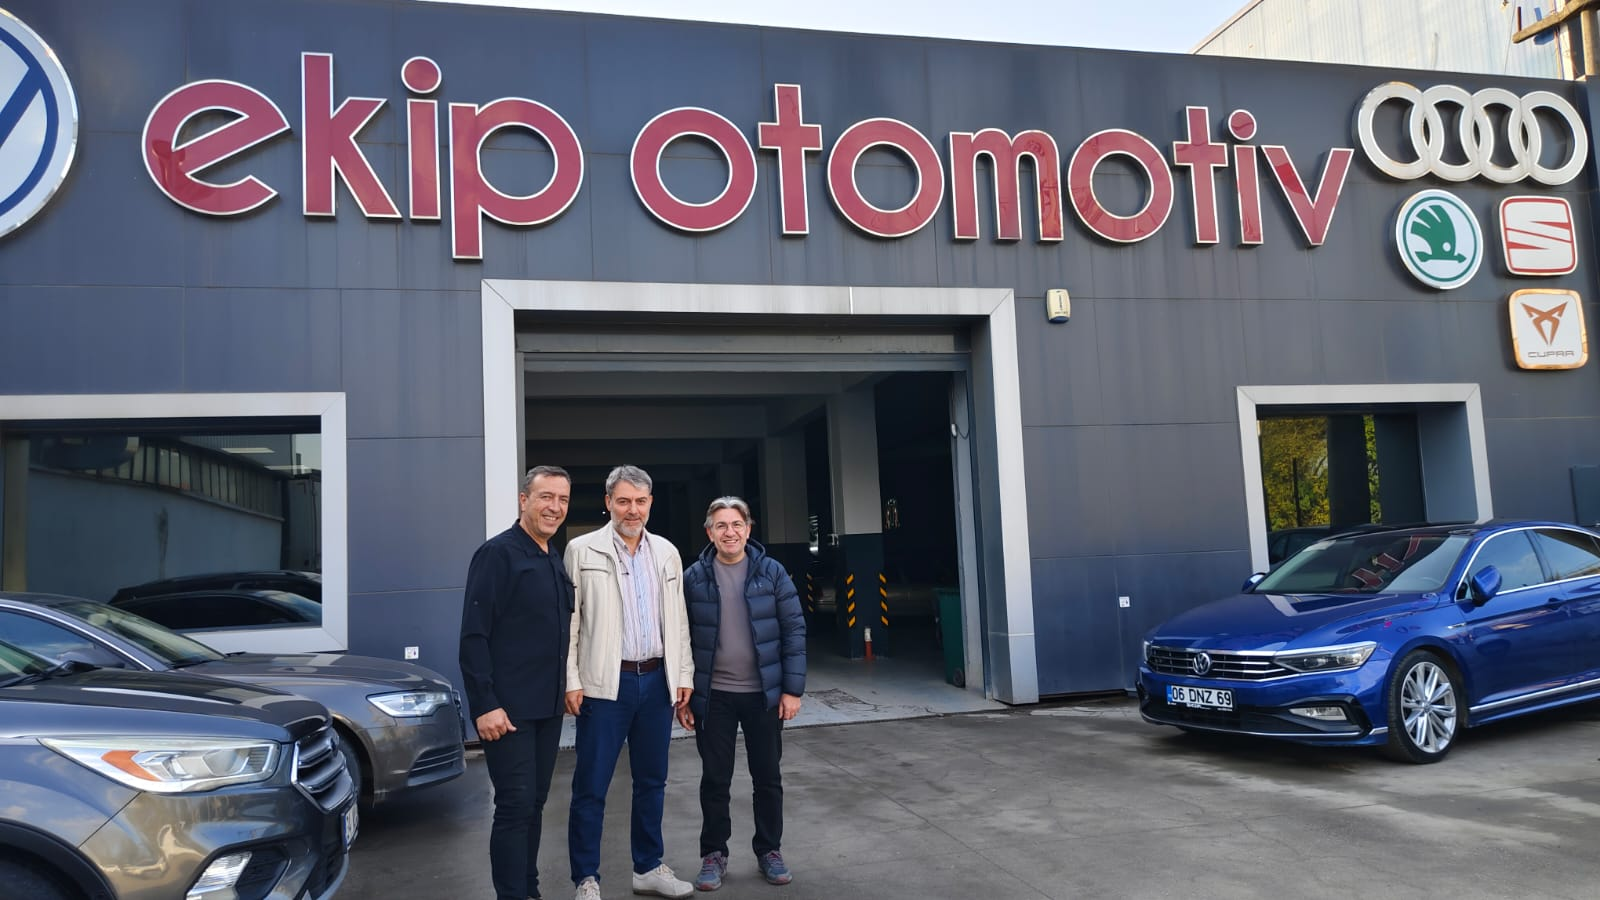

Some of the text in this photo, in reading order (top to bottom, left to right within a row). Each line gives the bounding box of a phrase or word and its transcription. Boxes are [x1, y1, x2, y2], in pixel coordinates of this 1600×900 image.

[141, 51, 1355, 261] ekip otomotiv
[1172, 686, 1231, 706] 06 DNZ 69
